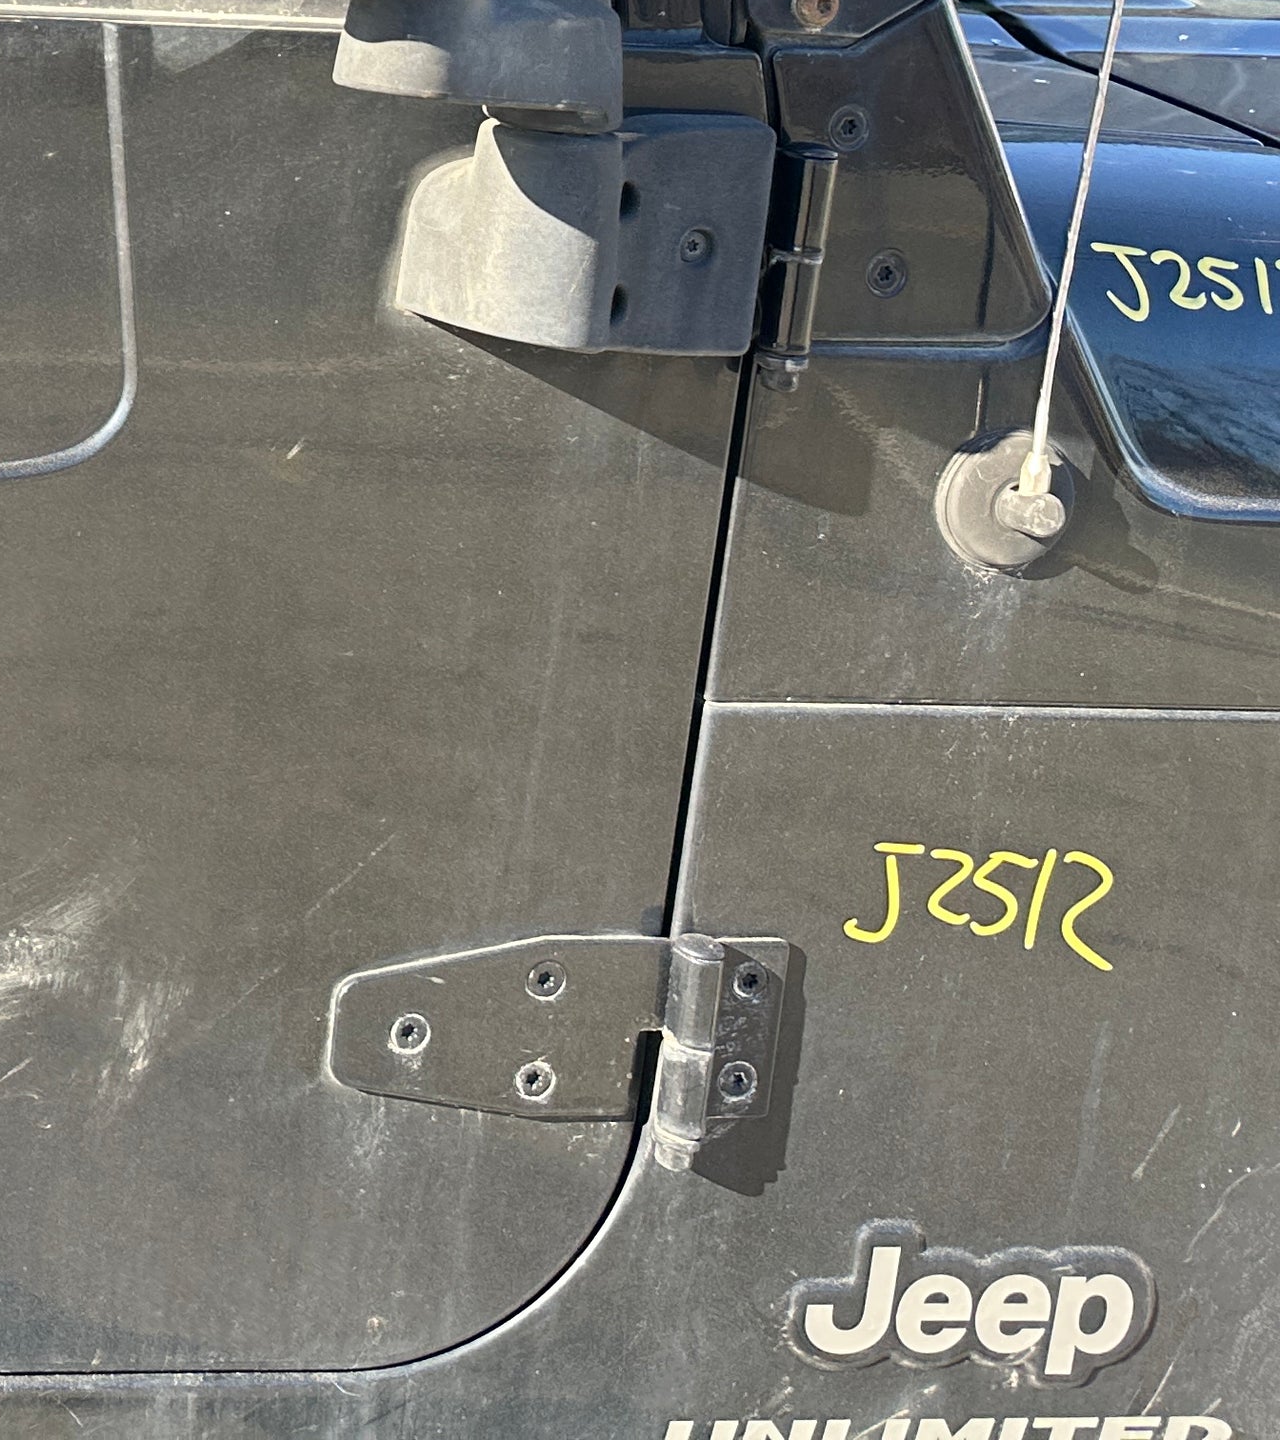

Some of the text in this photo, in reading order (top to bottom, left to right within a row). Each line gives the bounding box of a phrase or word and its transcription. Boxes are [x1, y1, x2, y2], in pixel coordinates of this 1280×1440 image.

[1090, 242, 1280, 322] J251
[843, 841, 1114, 971] J2512
[804, 1245, 1136, 1376] Jeep
